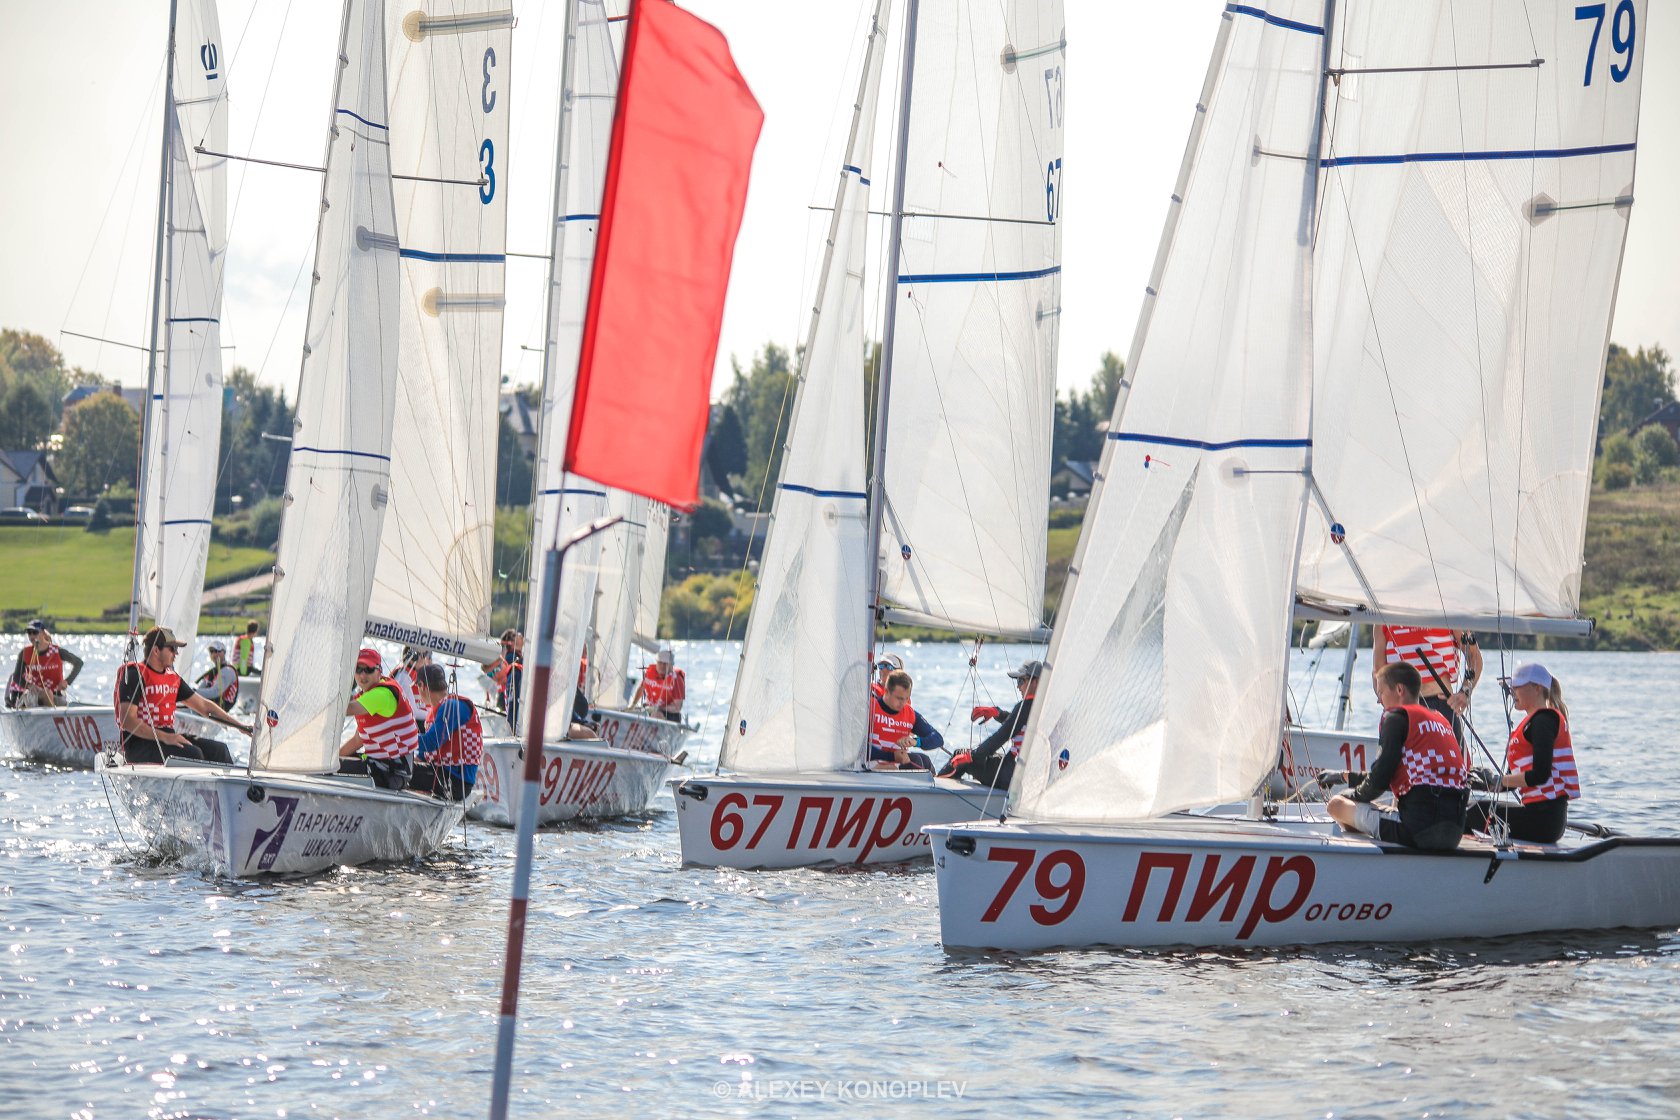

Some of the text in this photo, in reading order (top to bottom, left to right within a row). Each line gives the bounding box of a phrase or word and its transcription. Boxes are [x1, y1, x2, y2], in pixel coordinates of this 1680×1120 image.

[1575, 0, 1636, 86] 79
[479, 138, 496, 204] 3
[1046, 158, 1062, 221] 67
[1339, 742, 1367, 773] 11
[294, 813, 364, 834] ПАРУСНАЯ
[301, 839, 348, 858] ШКОЛА
[709, 792, 784, 852] 67
[980, 846, 1087, 926] 79
